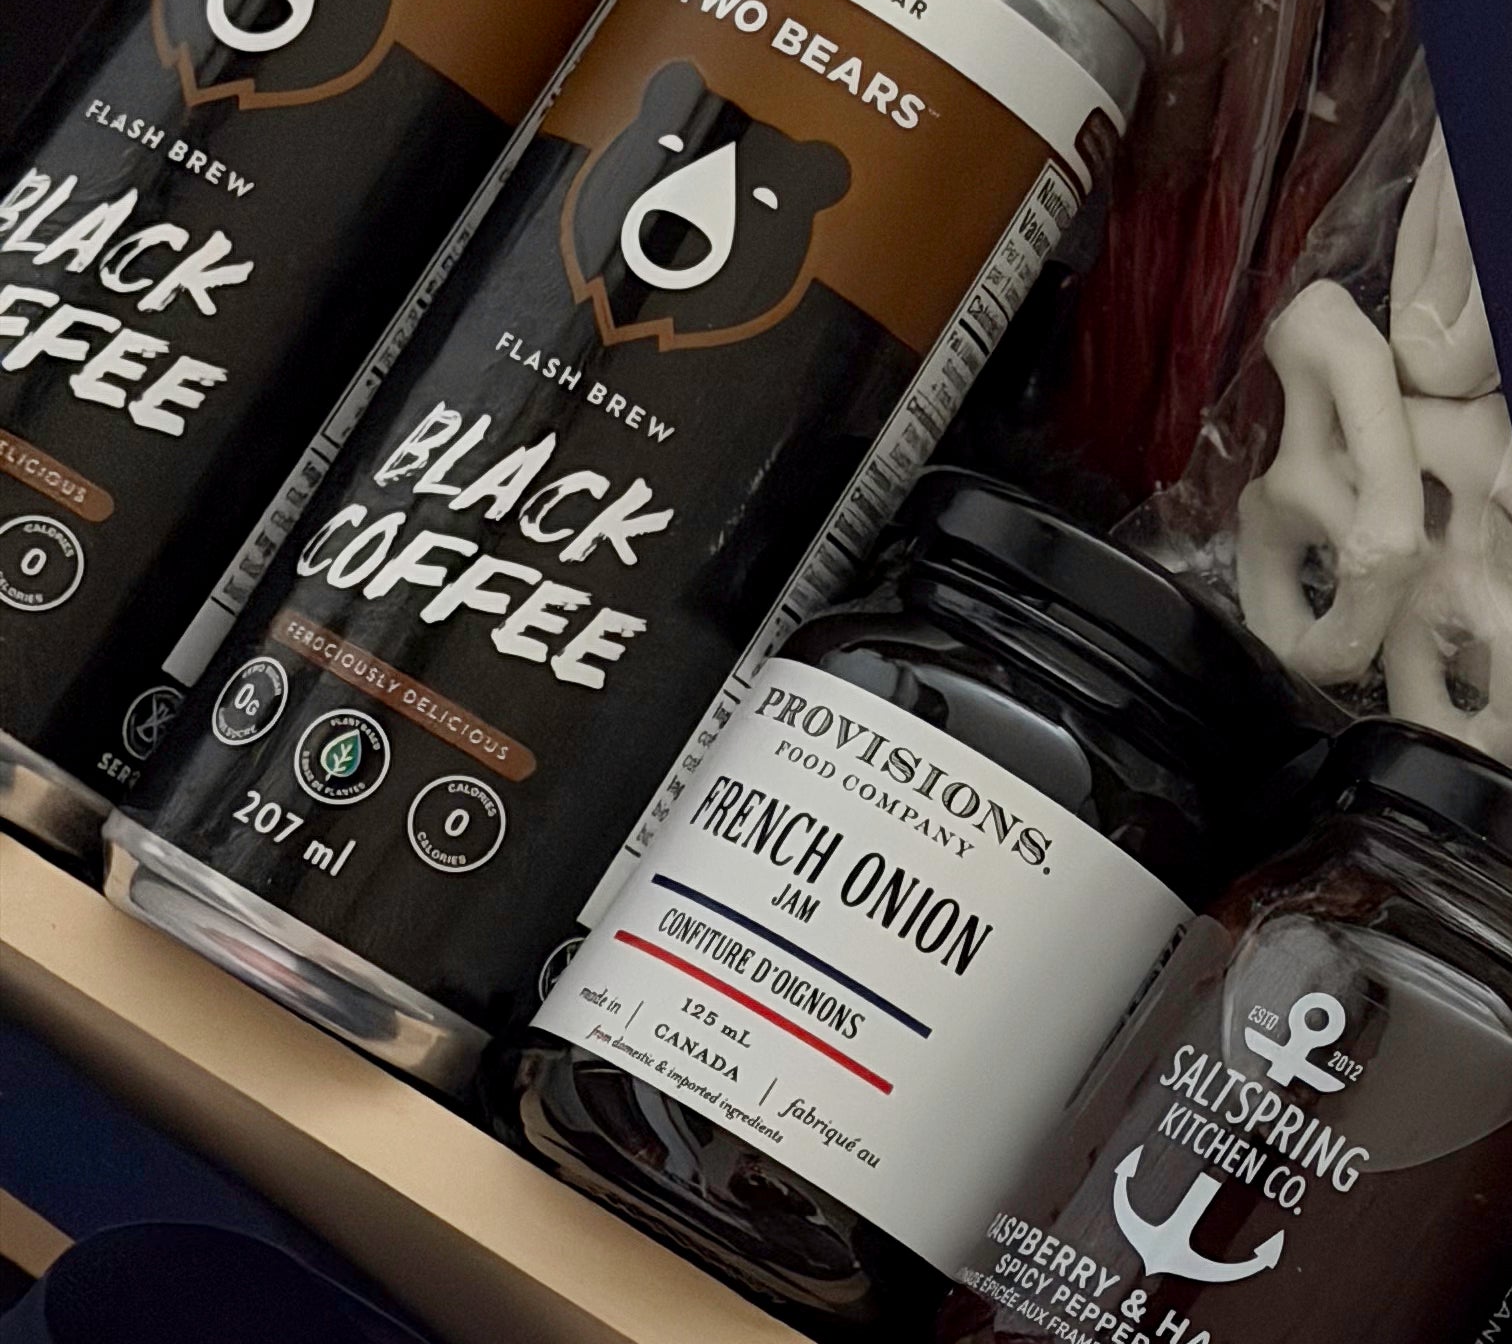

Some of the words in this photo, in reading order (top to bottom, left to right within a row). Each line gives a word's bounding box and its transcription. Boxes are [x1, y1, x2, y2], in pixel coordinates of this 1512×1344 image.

[772, 18, 926, 130] BEARS
[85, 98, 166, 149] FLASH
[167, 138, 256, 197] BREW
[0, 167, 255, 316] BLACK
[0, 284, 228, 437] FFEE
[495, 332, 581, 391] FLASH
[586, 382, 676, 445] BREW
[0, 440, 87, 504] ELICIOUS
[374, 402, 675, 566] BLACK
[20, 547, 47, 576] 0
[296, 504, 647, 690] COFFEE
[287, 621, 401, 694] FEROCIOUSLY
[402, 688, 510, 761] DELICIOUS
[233, 790, 304, 843] 207
[303, 839, 356, 877] ml
[444, 808, 470, 837] 0
[447, 782, 497, 818] CALORIES
[755, 686, 1055, 876] PROVISIONS.
[774, 739, 835, 780] FOOD
[842, 772, 977, 860] COMPANY
[417, 831, 467, 865] CALORIES
[690, 775, 844, 886] FRENCH
[840, 852, 994, 976] ONION
[771, 882, 820, 924] JAM
[607, 996, 622, 1014] in
[658, 908, 753, 974] CONFITURE
[750, 956, 866, 1040] D'OIGNONS
[681, 997, 719, 1026] 125
[720, 1023, 751, 1048] mL
[611, 1035, 655, 1067] domestic
[655, 1060, 668, 1073] &
[666, 1066, 722, 1105] imported
[719, 1097, 784, 1144] ingredients
[654, 1023, 740, 1083] CANADA
[778, 1098, 862, 1153] fabriqué
[857, 1147, 881, 1169] au
[1159, 1044, 1370, 1193] SALTSPRING
[1327, 1050, 1364, 1082] 2012
[1158, 1102, 1267, 1184] KITCHEN
[1263, 1166, 1306, 1215] CO.
[986, 1212, 1121, 1296] ASPBERRY
[1120, 1288, 1149, 1323] &
[995, 1253, 1053, 1296] SPICY
[1016, 1299, 1049, 1326] AUX
